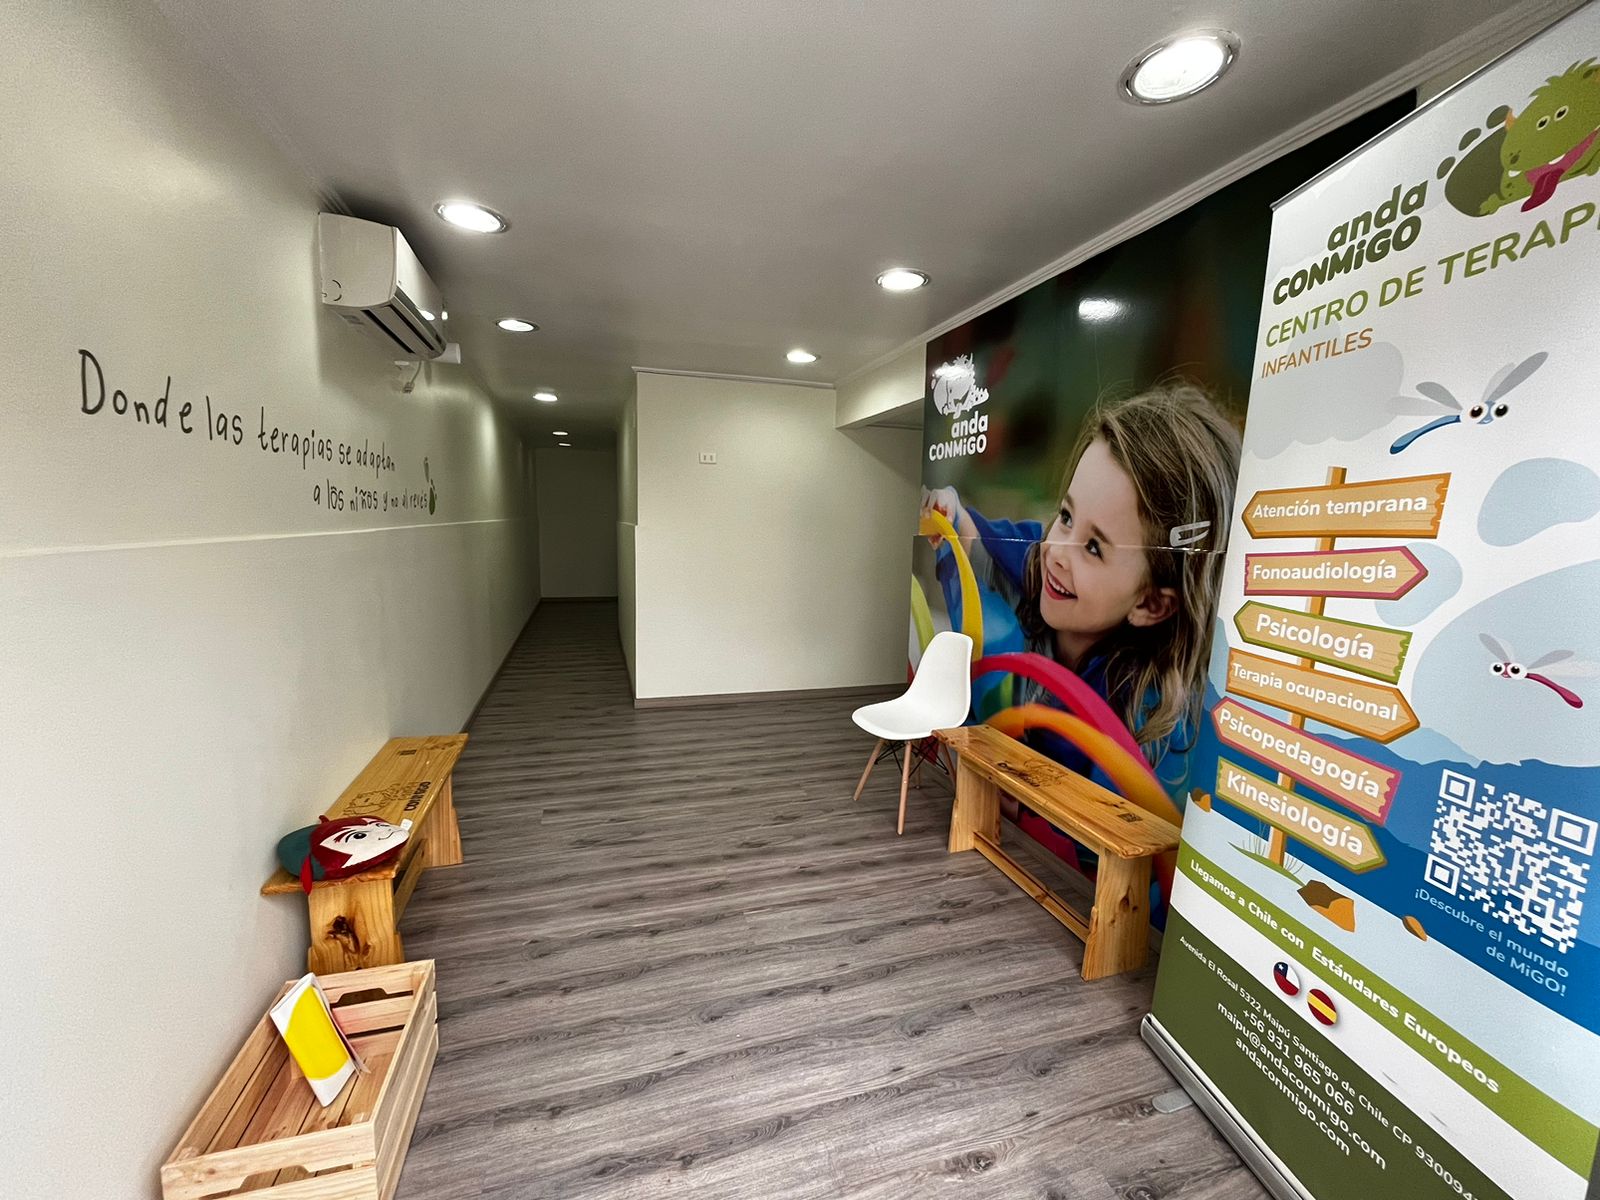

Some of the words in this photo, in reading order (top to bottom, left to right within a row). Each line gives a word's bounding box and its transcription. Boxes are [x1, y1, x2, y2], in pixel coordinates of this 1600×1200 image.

[1327, 180, 1428, 251] anda
[1265, 290, 1369, 348] CENTRO
[1379, 265, 1427, 308] DE
[1438, 202, 1600, 284] TERAP
[1261, 328, 1374, 379] INFANTILES
[79, 349, 193, 434] Donde
[206, 395, 243, 445] las
[257, 406, 333, 470] terapias
[339, 443, 352, 465] se
[356, 438, 396, 479] adaptan
[951, 410, 989, 438] anda
[313, 484, 321, 505] a
[350, 486, 379, 512] niños
[383, 490, 388, 512] y
[1252, 499, 1320, 519] Atención
[1326, 496, 1428, 517] temprana
[1253, 559, 1397, 583] Fonoaudiología
[1256, 613, 1375, 660] Psicología
[1232, 663, 1283, 689] Terapia
[1286, 681, 1399, 721] ocupacional
[1219, 708, 1380, 798] Psicopedagogía
[1226, 770, 1364, 856] Kinesiología
[1190, 859, 1237, 900] Llegamos
[1238, 897, 1246, 907] a
[1248, 902, 1279, 931] Chile
[1280, 927, 1305, 950] con
[1311, 946, 1400, 1019] Estándares
[1403, 1012, 1501, 1094] Europeos
[1414, 888, 1485, 933] ¡Descubre
[1488, 929, 1503, 943] el
[1506, 939, 1570, 979] mundo
[1486, 945, 1507, 963] de
[1509, 957, 1567, 997] MiGO!
[1179, 936, 1208, 965] Avenida
[1208, 960, 1217, 972] El
[1216, 967, 1239, 992] Rosal
[1238, 987, 1262, 1013] 5322
[1262, 1008, 1291, 1039] Maipú
[1292, 1034, 1340, 1081] Santiago
[1341, 1079, 1357, 1097] de
[1358, 1094, 1390, 1128] Chile
[1392, 1125, 1413, 1145] CP
[1415, 1145, 1480, 1200] 930094
[1217, 1002, 1387, 1171] maipu@andaconmigo.com
[1235, 1036, 1351, 1157] andaconmigo.com
[1242, 1008, 1266, 1034] +56
[1267, 1029, 1291, 1059] 931
[1294, 1053, 1322, 1085] 965
[1324, 1082, 1356, 1117] 066
